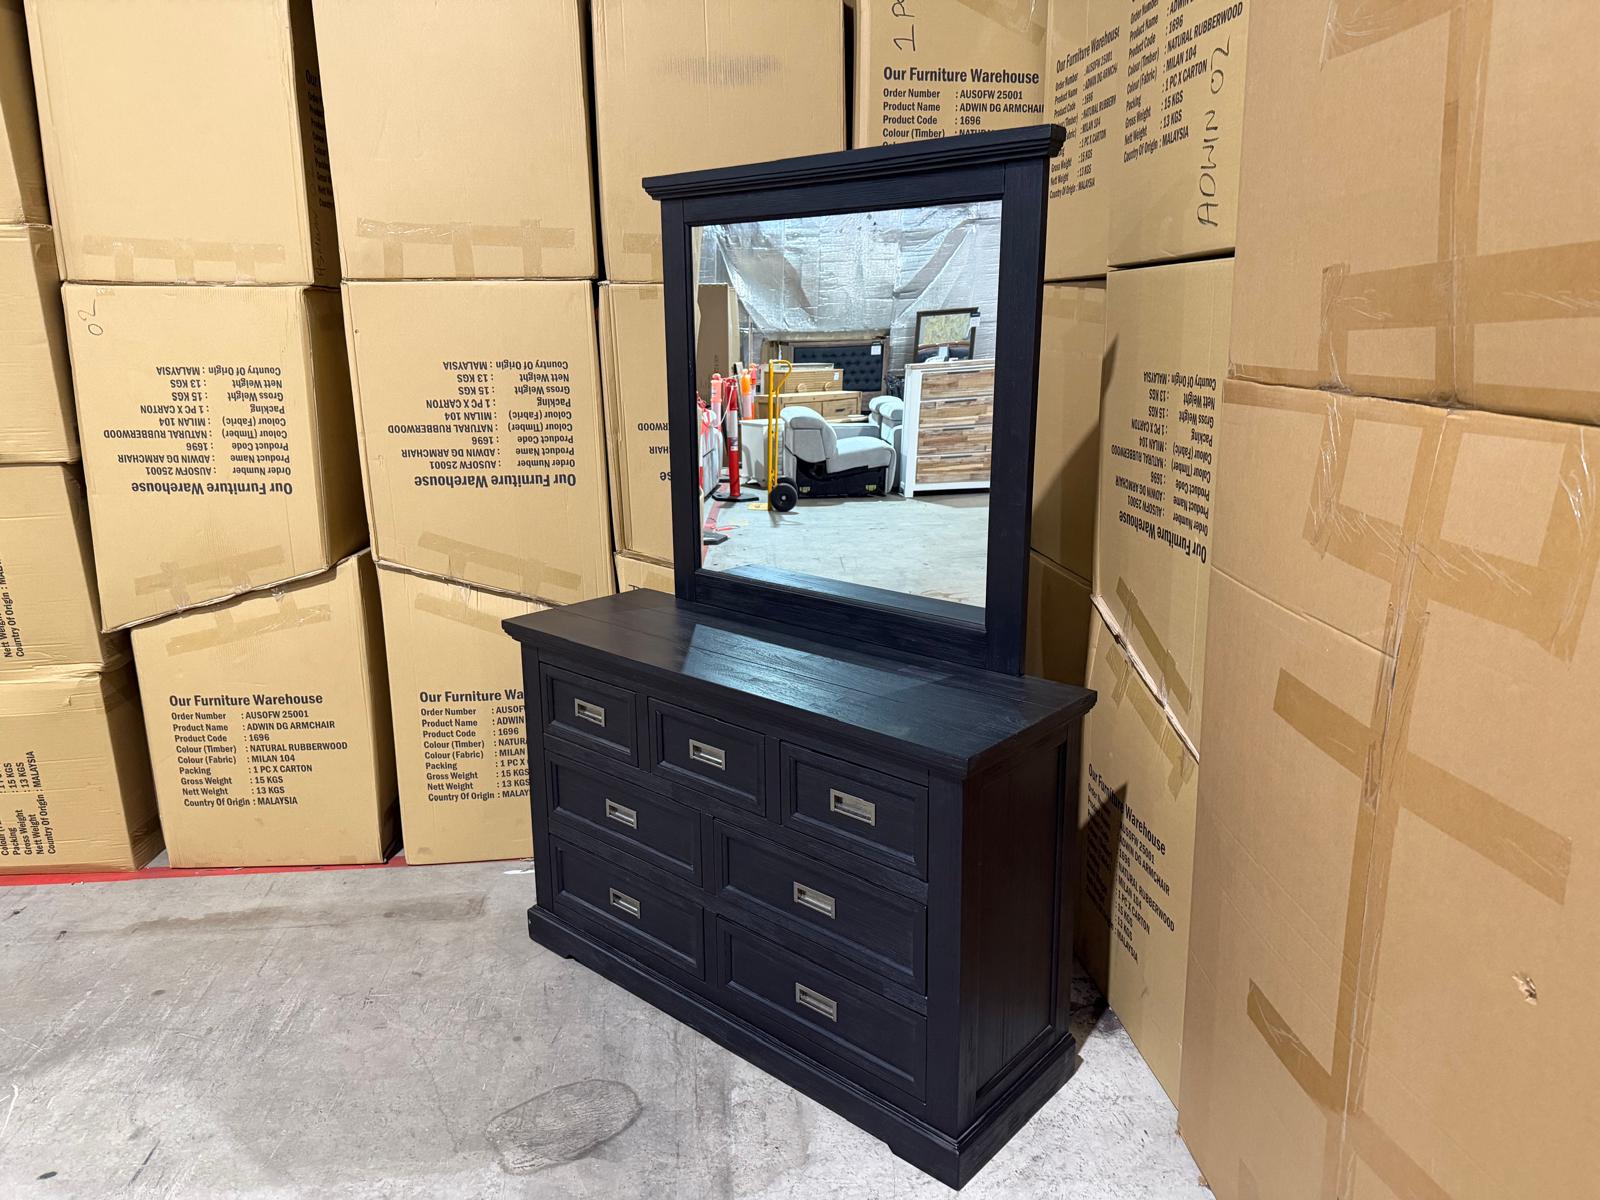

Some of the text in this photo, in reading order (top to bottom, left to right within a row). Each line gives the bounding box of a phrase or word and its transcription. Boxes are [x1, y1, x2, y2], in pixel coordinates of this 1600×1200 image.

[1128, 2, 1242, 76] Colour (Timber) NATURAL RUBBERWOOD
[884, 67, 1039, 83] Our Furniture Warehouse
[883, 88, 1022, 99] Order Number AUSOFW 25001
[883, 102, 915, 111] Product
[917, 103, 940, 111] Name
[960, 103, 987, 111] ADWIN
[990, 104, 1001, 112] DG
[883, 116, 981, 124] Product Code 1696
[883, 128, 945, 138] Colour (Timber)
[1162, 126, 1188, 146] MALAYSIA
[443, 360, 568, 370] Country Of Origin MALAYSIA
[156, 365, 281, 376] Country Of Origin MALAYSIA
[170, 378, 282, 388] Nett Weight 13 KGS
[1187, 376, 1193, 388] Of
[1194, 374, 1216, 390] Country
[444, 411, 572, 420] Colour (Fabric) MILAN 104
[158, 417, 286, 426] Colour (Fabric) MILAN 104
[388, 423, 572, 433] Colour (Timber) NATURAL RUBBERWOOD
[103, 430, 166, 438] RUBBERWOOD
[168, 430, 207, 438] NATURAL
[222, 430, 258, 439] (Timber)
[540, 435, 573, 443] Product
[402, 449, 449, 457] ARMCHAIR
[451, 449, 464, 457] DG
[541, 447, 574, 455] Product
[181, 455, 210, 463] ADWIN
[552, 459, 575, 467] Order
[430, 461, 457, 469] 25001
[459, 461, 496, 469] AUSOFW
[146, 467, 291, 475] Order Number AUSOFW 25001
[414, 474, 576, 487] Our Furniture Warehouse
[131, 483, 293, 494] Our Furniture Warehouse
[1120, 510, 1206, 564] Our Furniture Warehouse
[169, 694, 322, 706] Our Furniture Warehouse
[419, 692, 442, 702] Our
[445, 691, 501, 702] Furniture
[195, 712, 227, 720] Number
[290, 721, 334, 729] ARMCHAIR
[423, 730, 454, 738] Product
[203, 745, 237, 753] (Timber)
[250, 744, 286, 752] NATURAL
[289, 742, 347, 750] RUBBERWOOD
[205, 755, 237, 764] (Fabric)
[178, 767, 211, 775] Packing
[204, 777, 232, 786] Weight
[200, 788, 228, 796] Weight
[26, 750, 56, 854] Country Of Origin MALAYSIA
[183, 799, 214, 807] Country
[226, 798, 250, 806] Origin
[257, 797, 297, 805] MALAYSIA
[1089, 763, 1098, 782] Our
[1126, 803, 1165, 855] Warehouse
